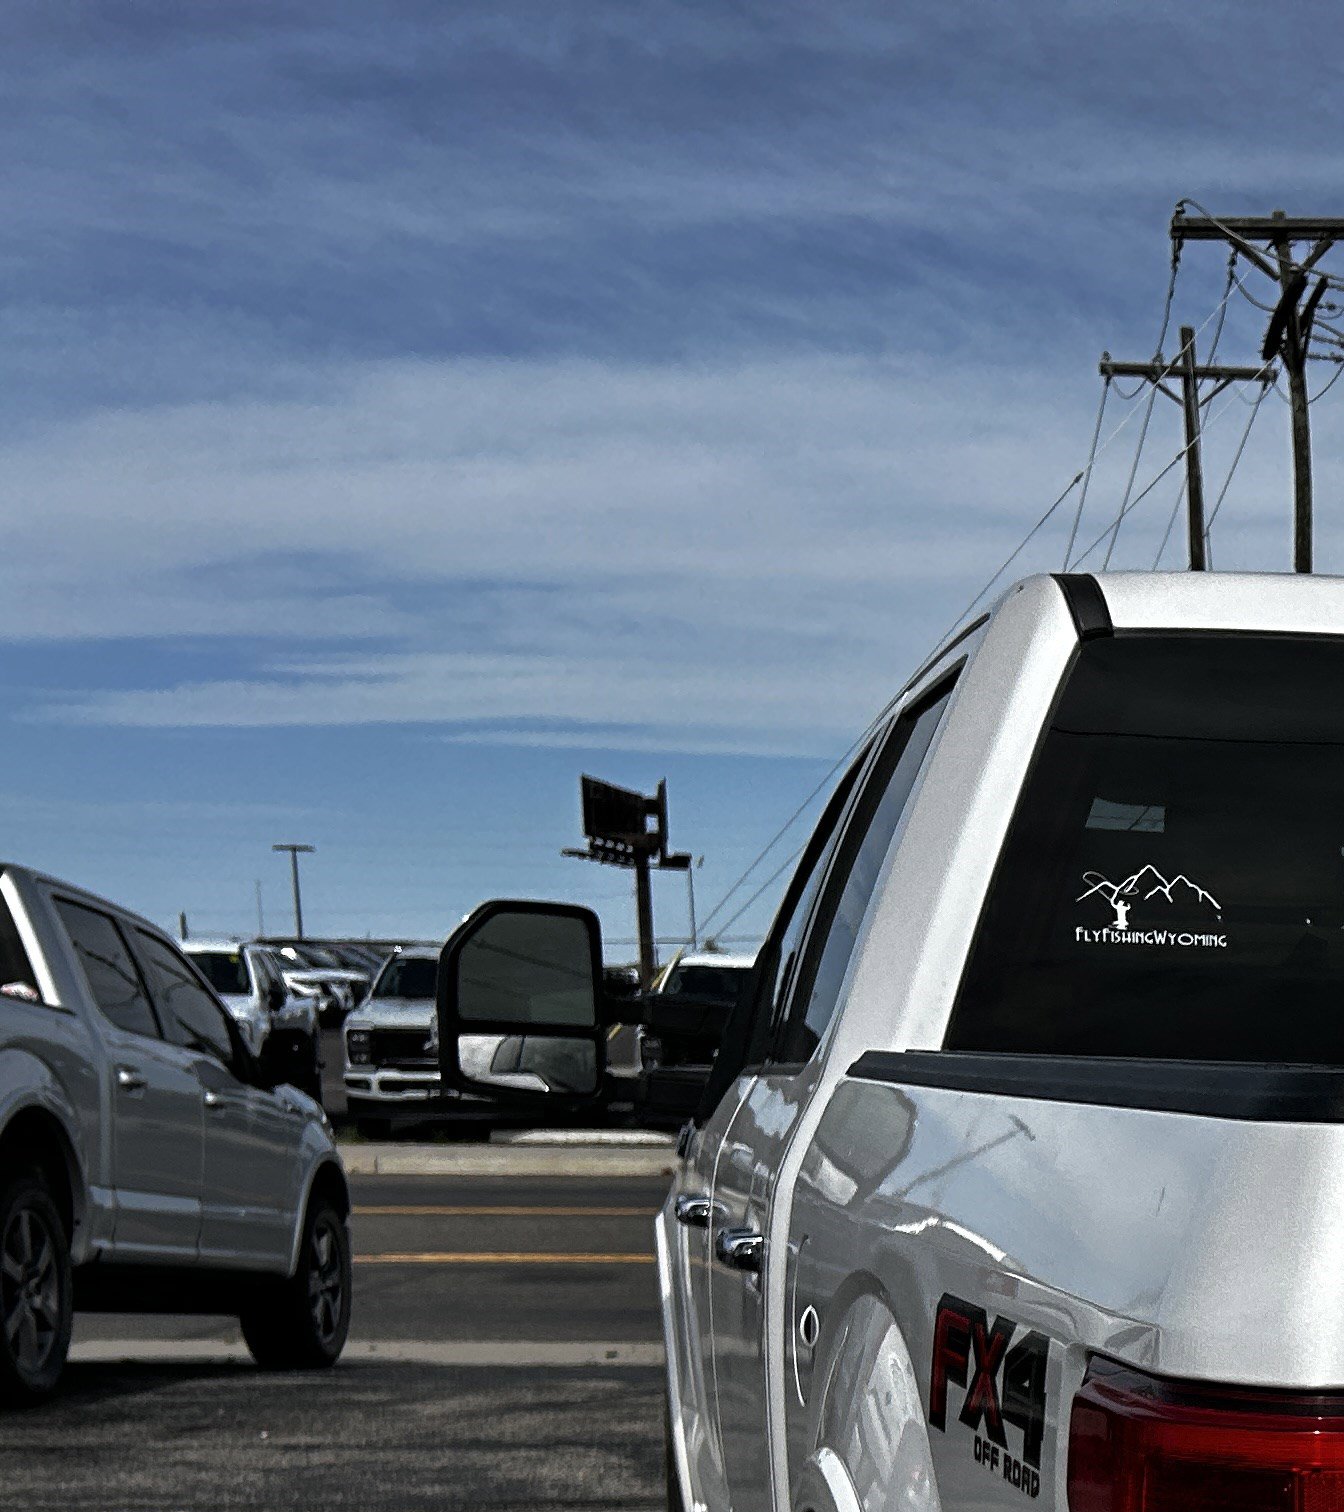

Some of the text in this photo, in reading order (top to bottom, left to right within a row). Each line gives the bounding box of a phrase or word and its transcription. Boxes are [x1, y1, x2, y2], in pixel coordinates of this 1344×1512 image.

[929, 1292, 1050, 1471] FX4
[974, 1435, 1041, 1498] OFF ROAD
